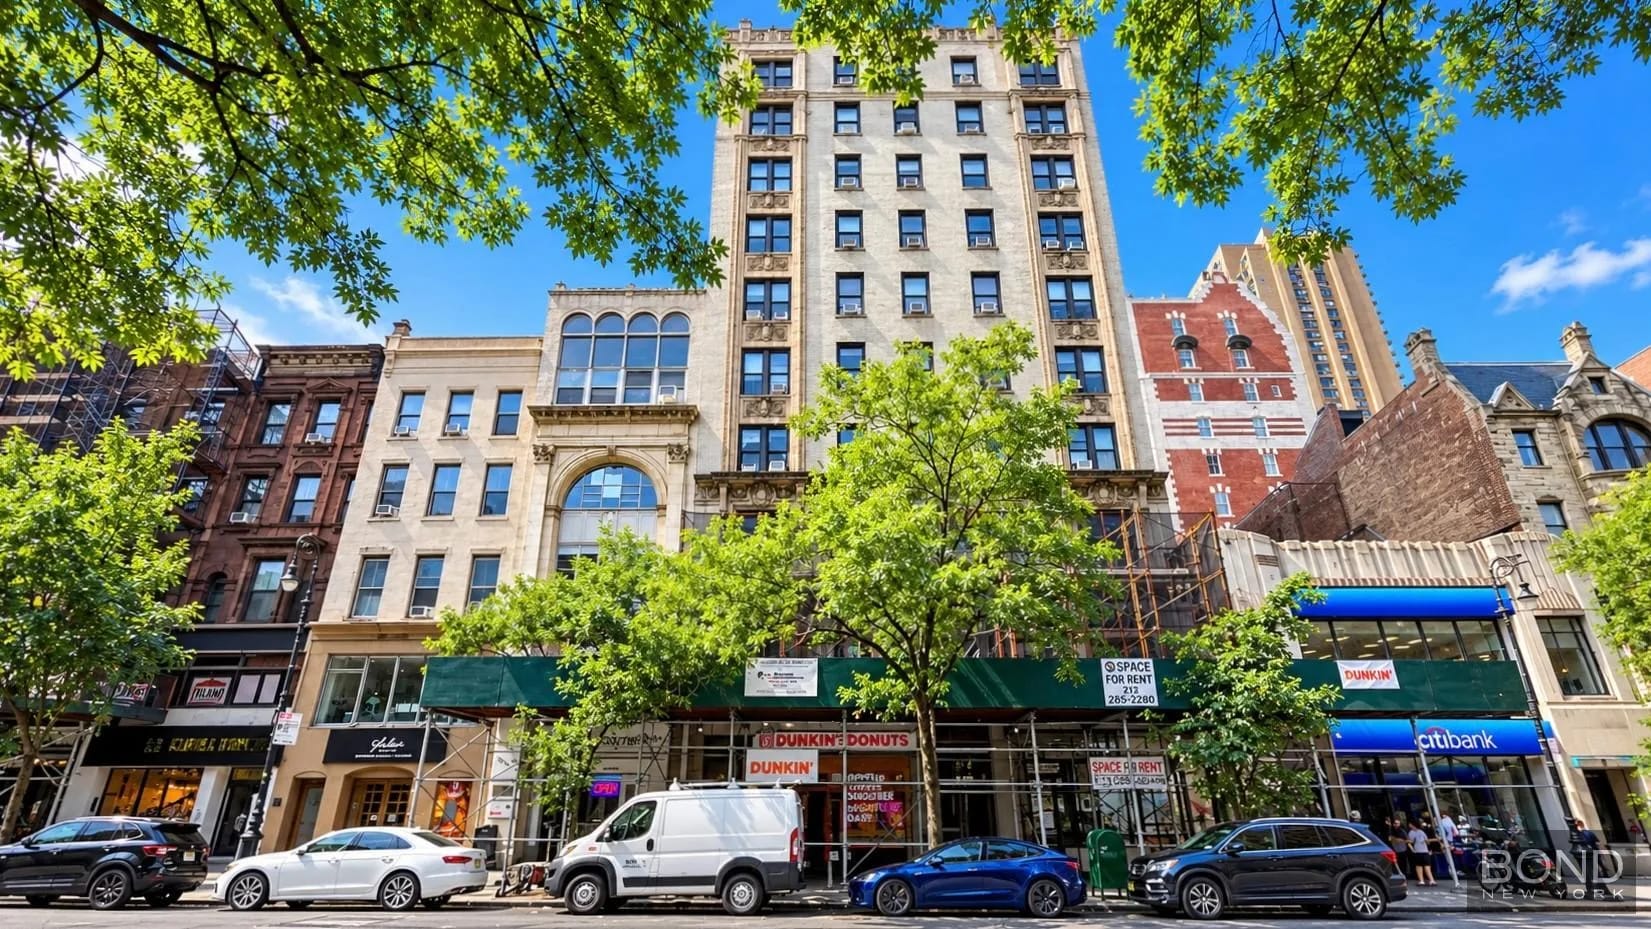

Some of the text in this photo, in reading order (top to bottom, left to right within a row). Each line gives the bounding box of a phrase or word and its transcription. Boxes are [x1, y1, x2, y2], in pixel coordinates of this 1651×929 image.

[1117, 661, 1151, 672] SPACE
[1106, 674, 1152, 684] FOR RENT
[1344, 669, 1392, 681] DUNKIN'
[1123, 686, 1138, 694] 212
[1108, 695, 1155, 704] 285-2280
[847, 733, 909, 747] DONUTS
[1420, 729, 1497, 749] citibank
[751, 761, 813, 774] DUNKIN'
[1092, 761, 1122, 773] SPACE
[1138, 761, 1162, 773] RENT
